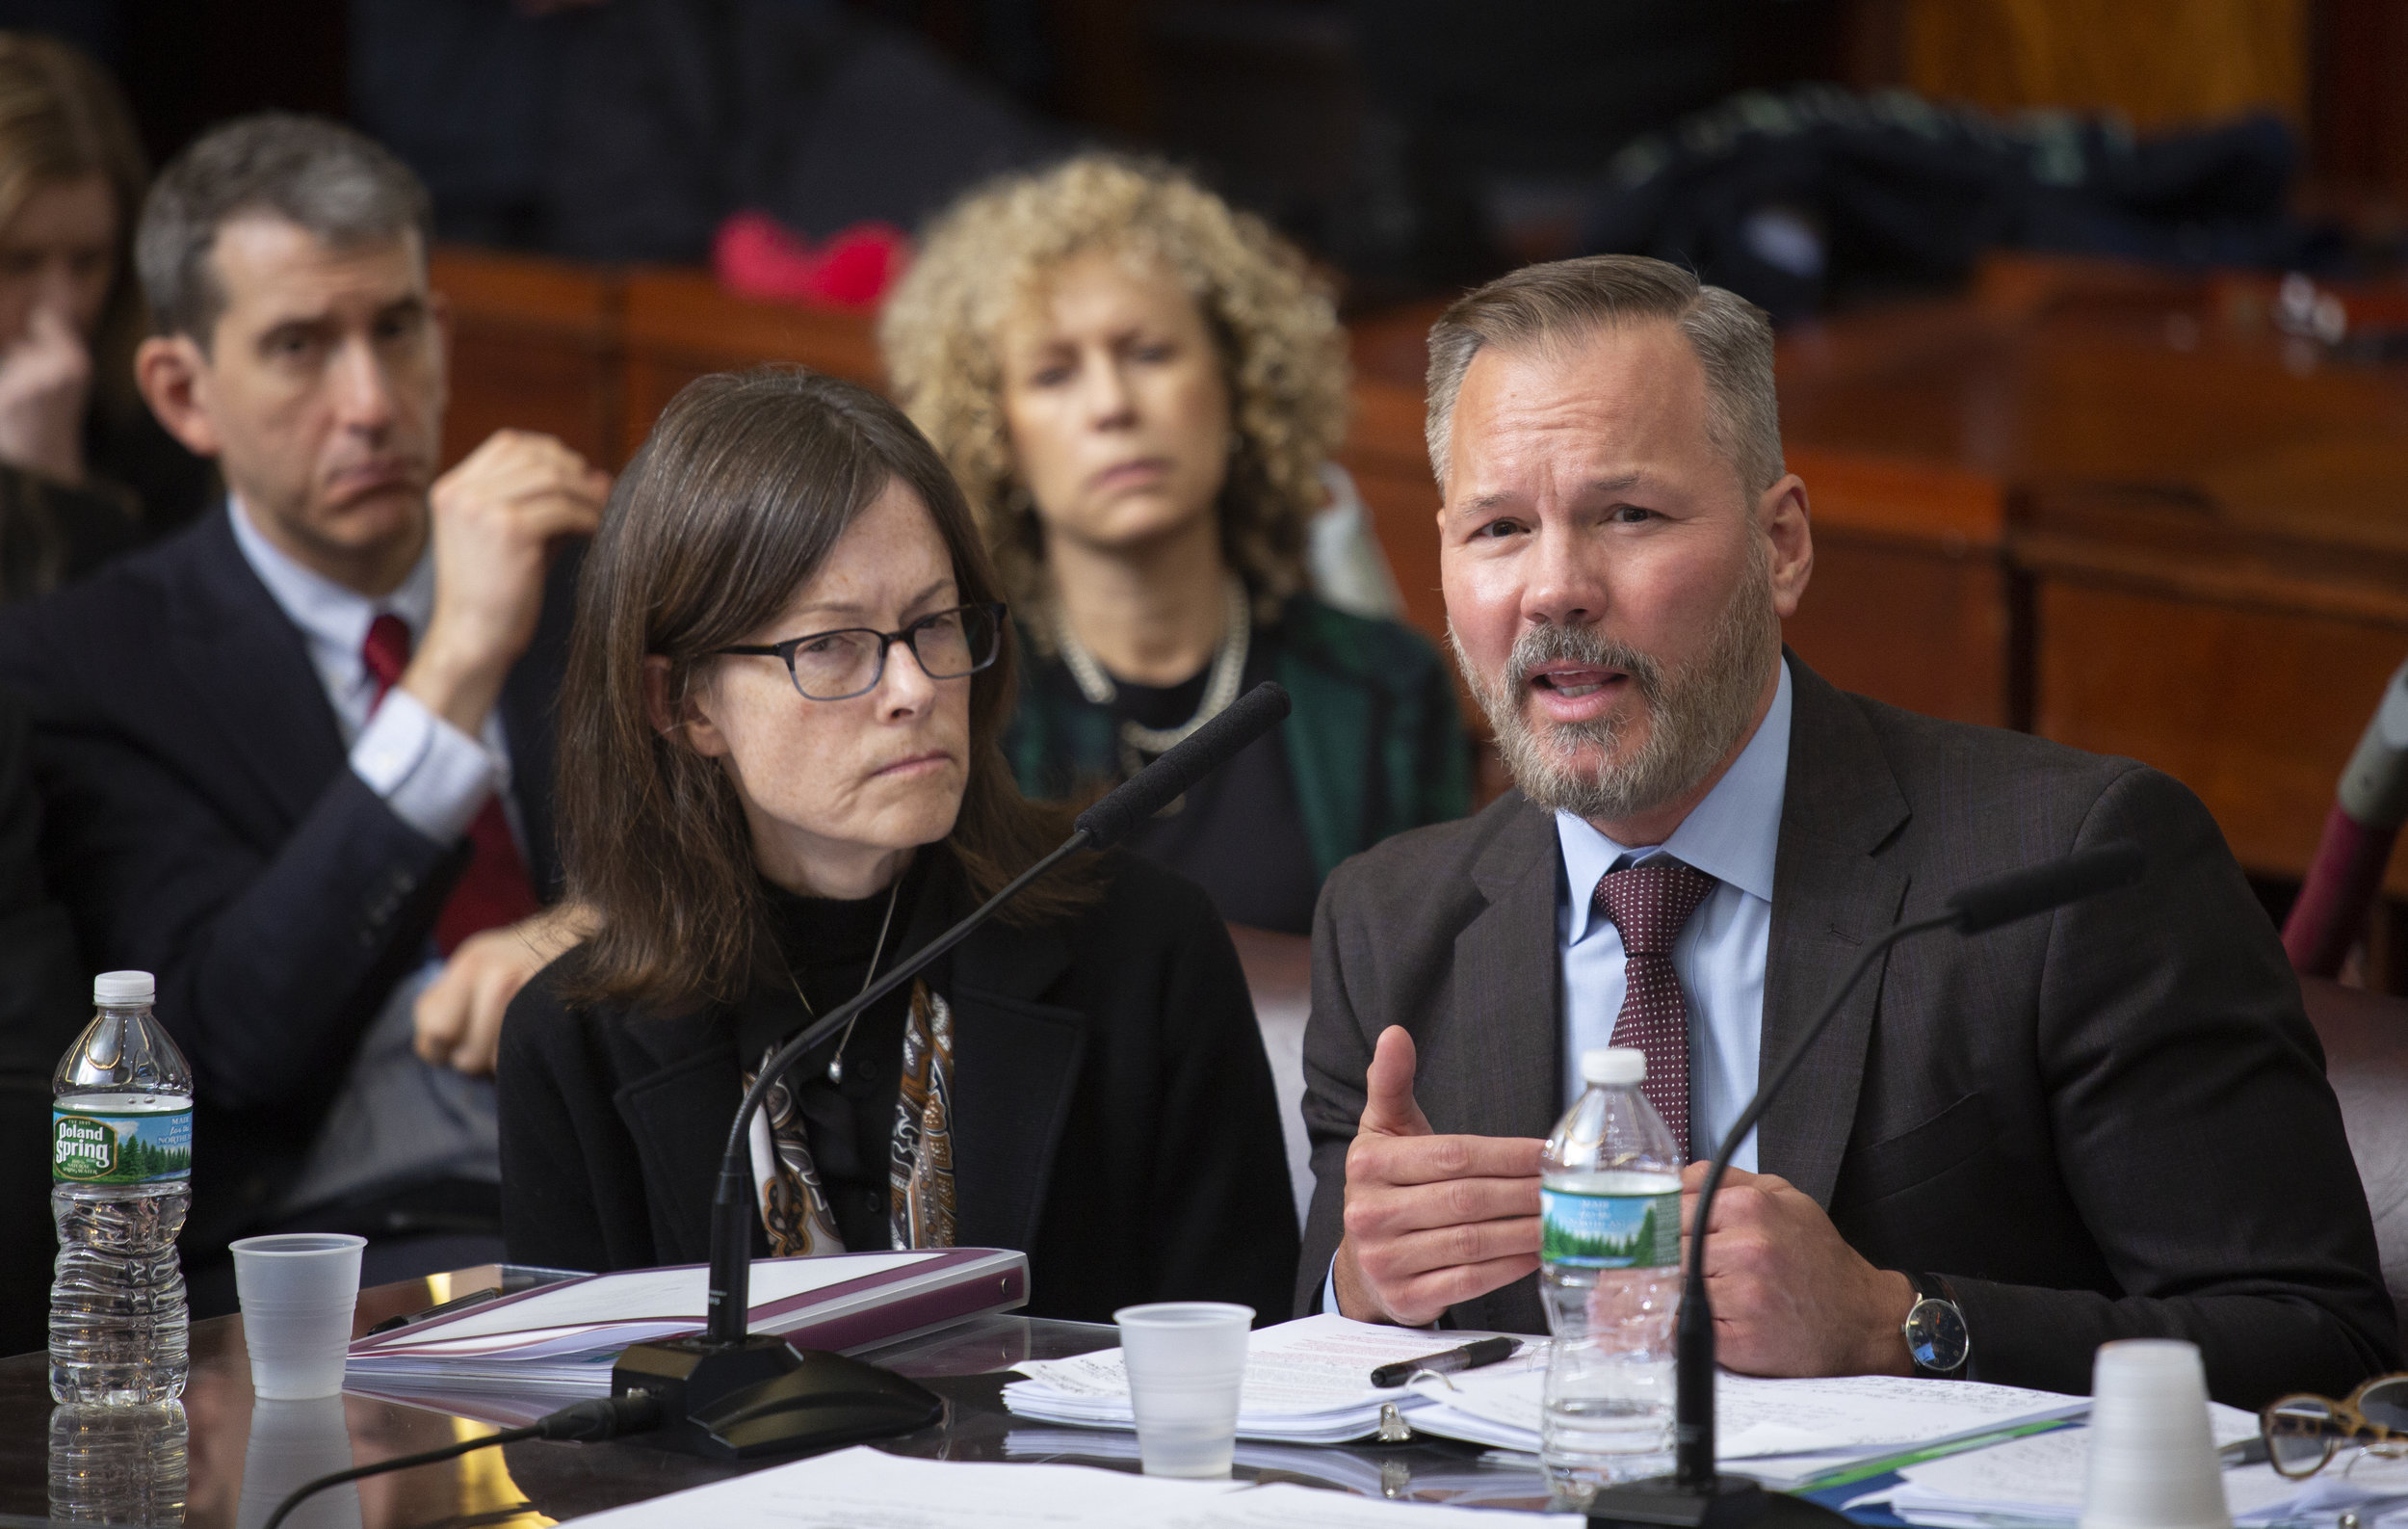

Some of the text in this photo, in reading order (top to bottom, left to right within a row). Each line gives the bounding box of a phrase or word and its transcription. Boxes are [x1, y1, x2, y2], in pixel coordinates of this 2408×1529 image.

[59, 1122, 104, 1142] Poland
[170, 1125, 182, 1136] for
[56, 1139, 110, 1168] Spring
